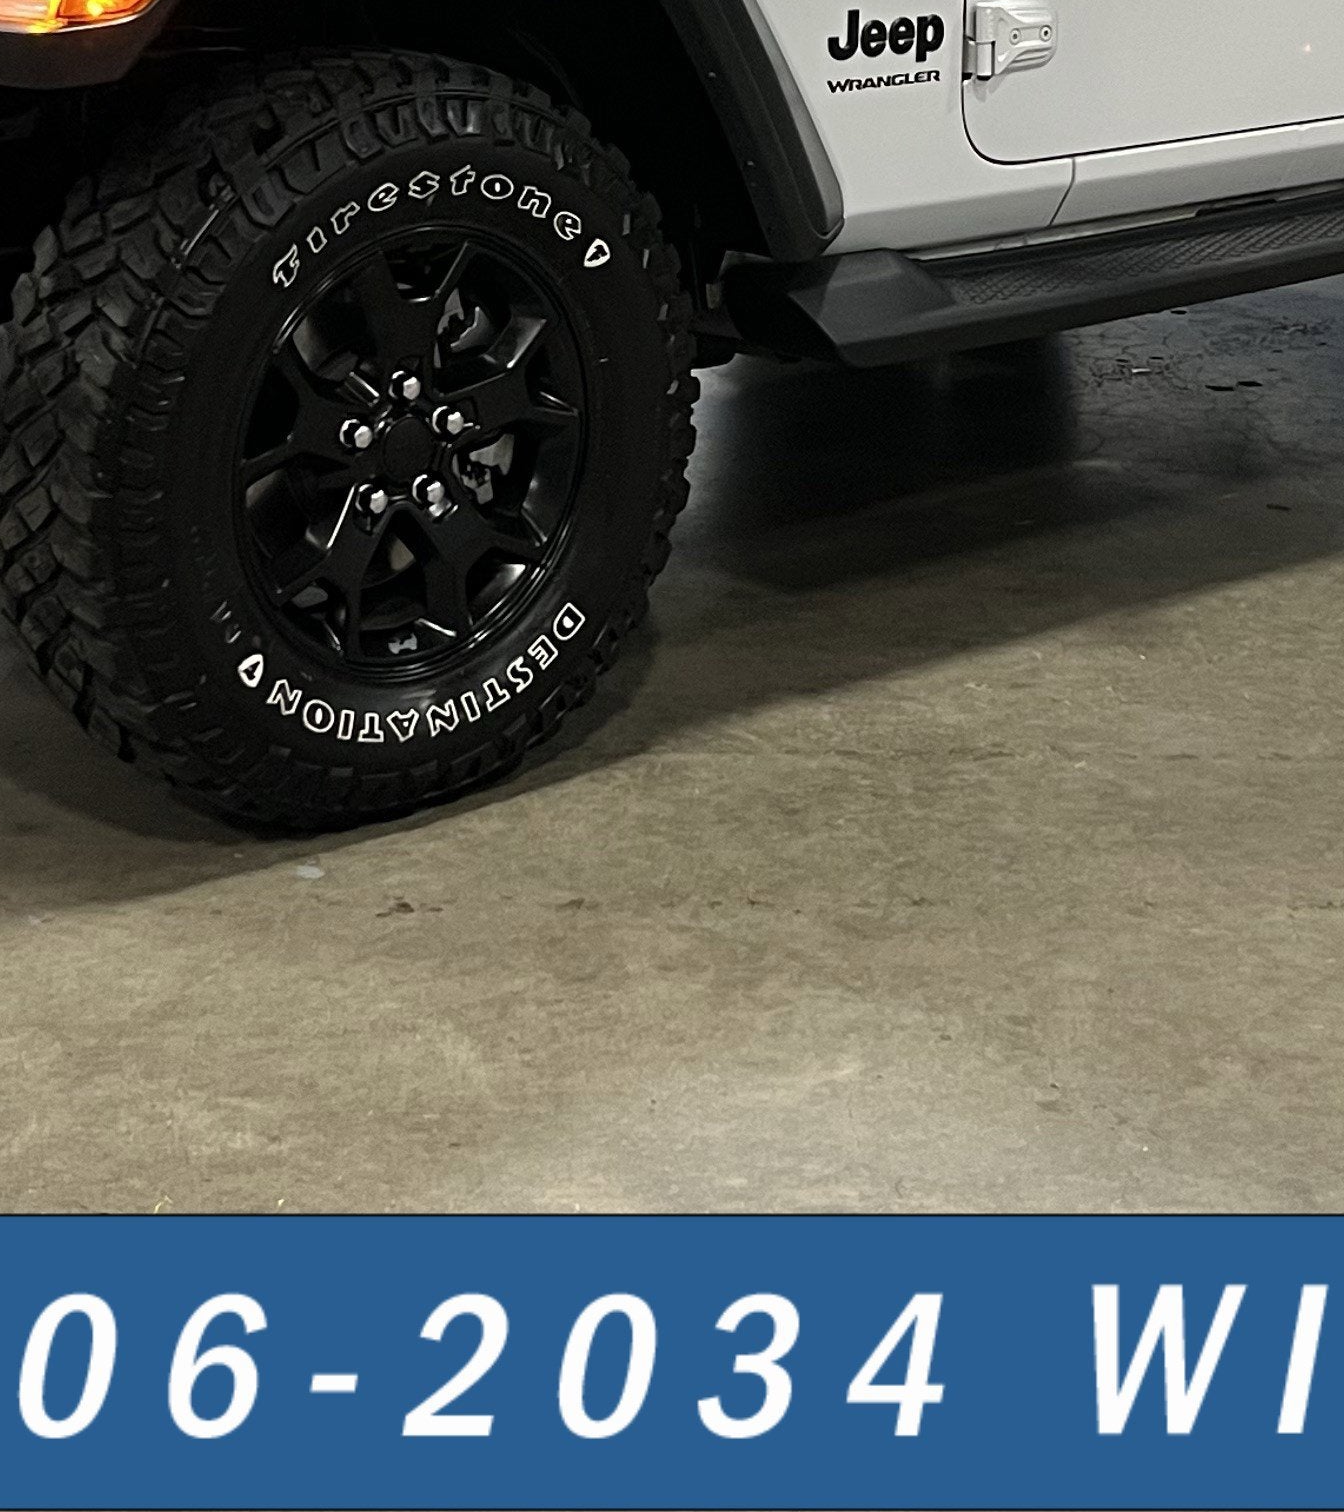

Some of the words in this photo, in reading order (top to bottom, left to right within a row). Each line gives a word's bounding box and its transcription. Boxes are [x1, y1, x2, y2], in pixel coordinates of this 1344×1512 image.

[827, 8, 945, 63] Jeep
[826, 70, 941, 94] WRANGLER
[272, 164, 582, 288] Firestone
[266, 601, 587, 743] DESTINATION
